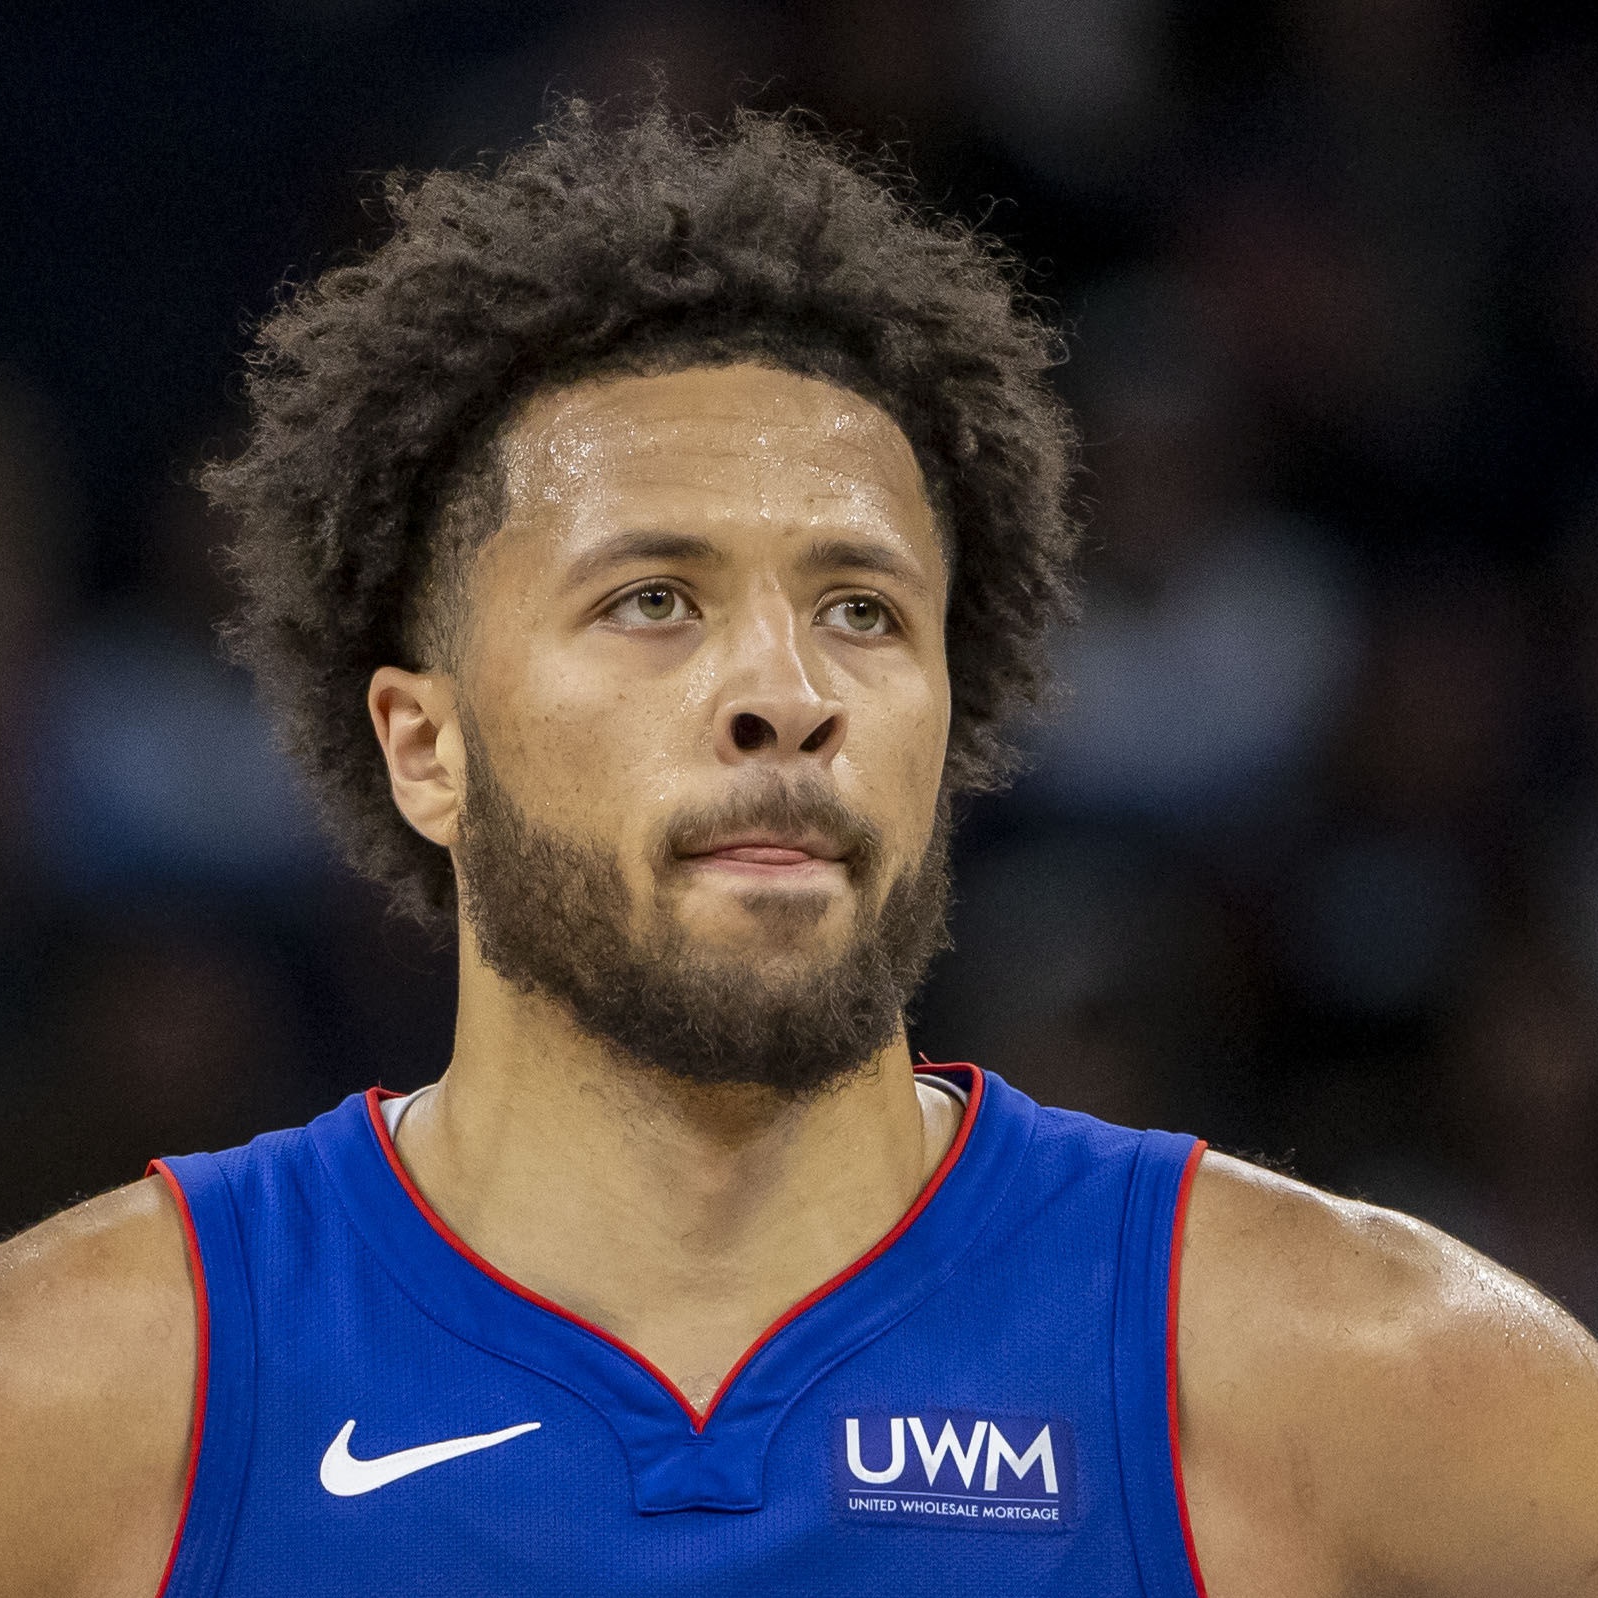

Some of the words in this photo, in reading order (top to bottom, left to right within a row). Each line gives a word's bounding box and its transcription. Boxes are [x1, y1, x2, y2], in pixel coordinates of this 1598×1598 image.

[845, 1416, 1059, 1494] UWM
[849, 1498, 897, 1513] UNITED
[900, 1500, 979, 1518] WHOLESALE
[982, 1506, 1060, 1521] MORTGAGE
